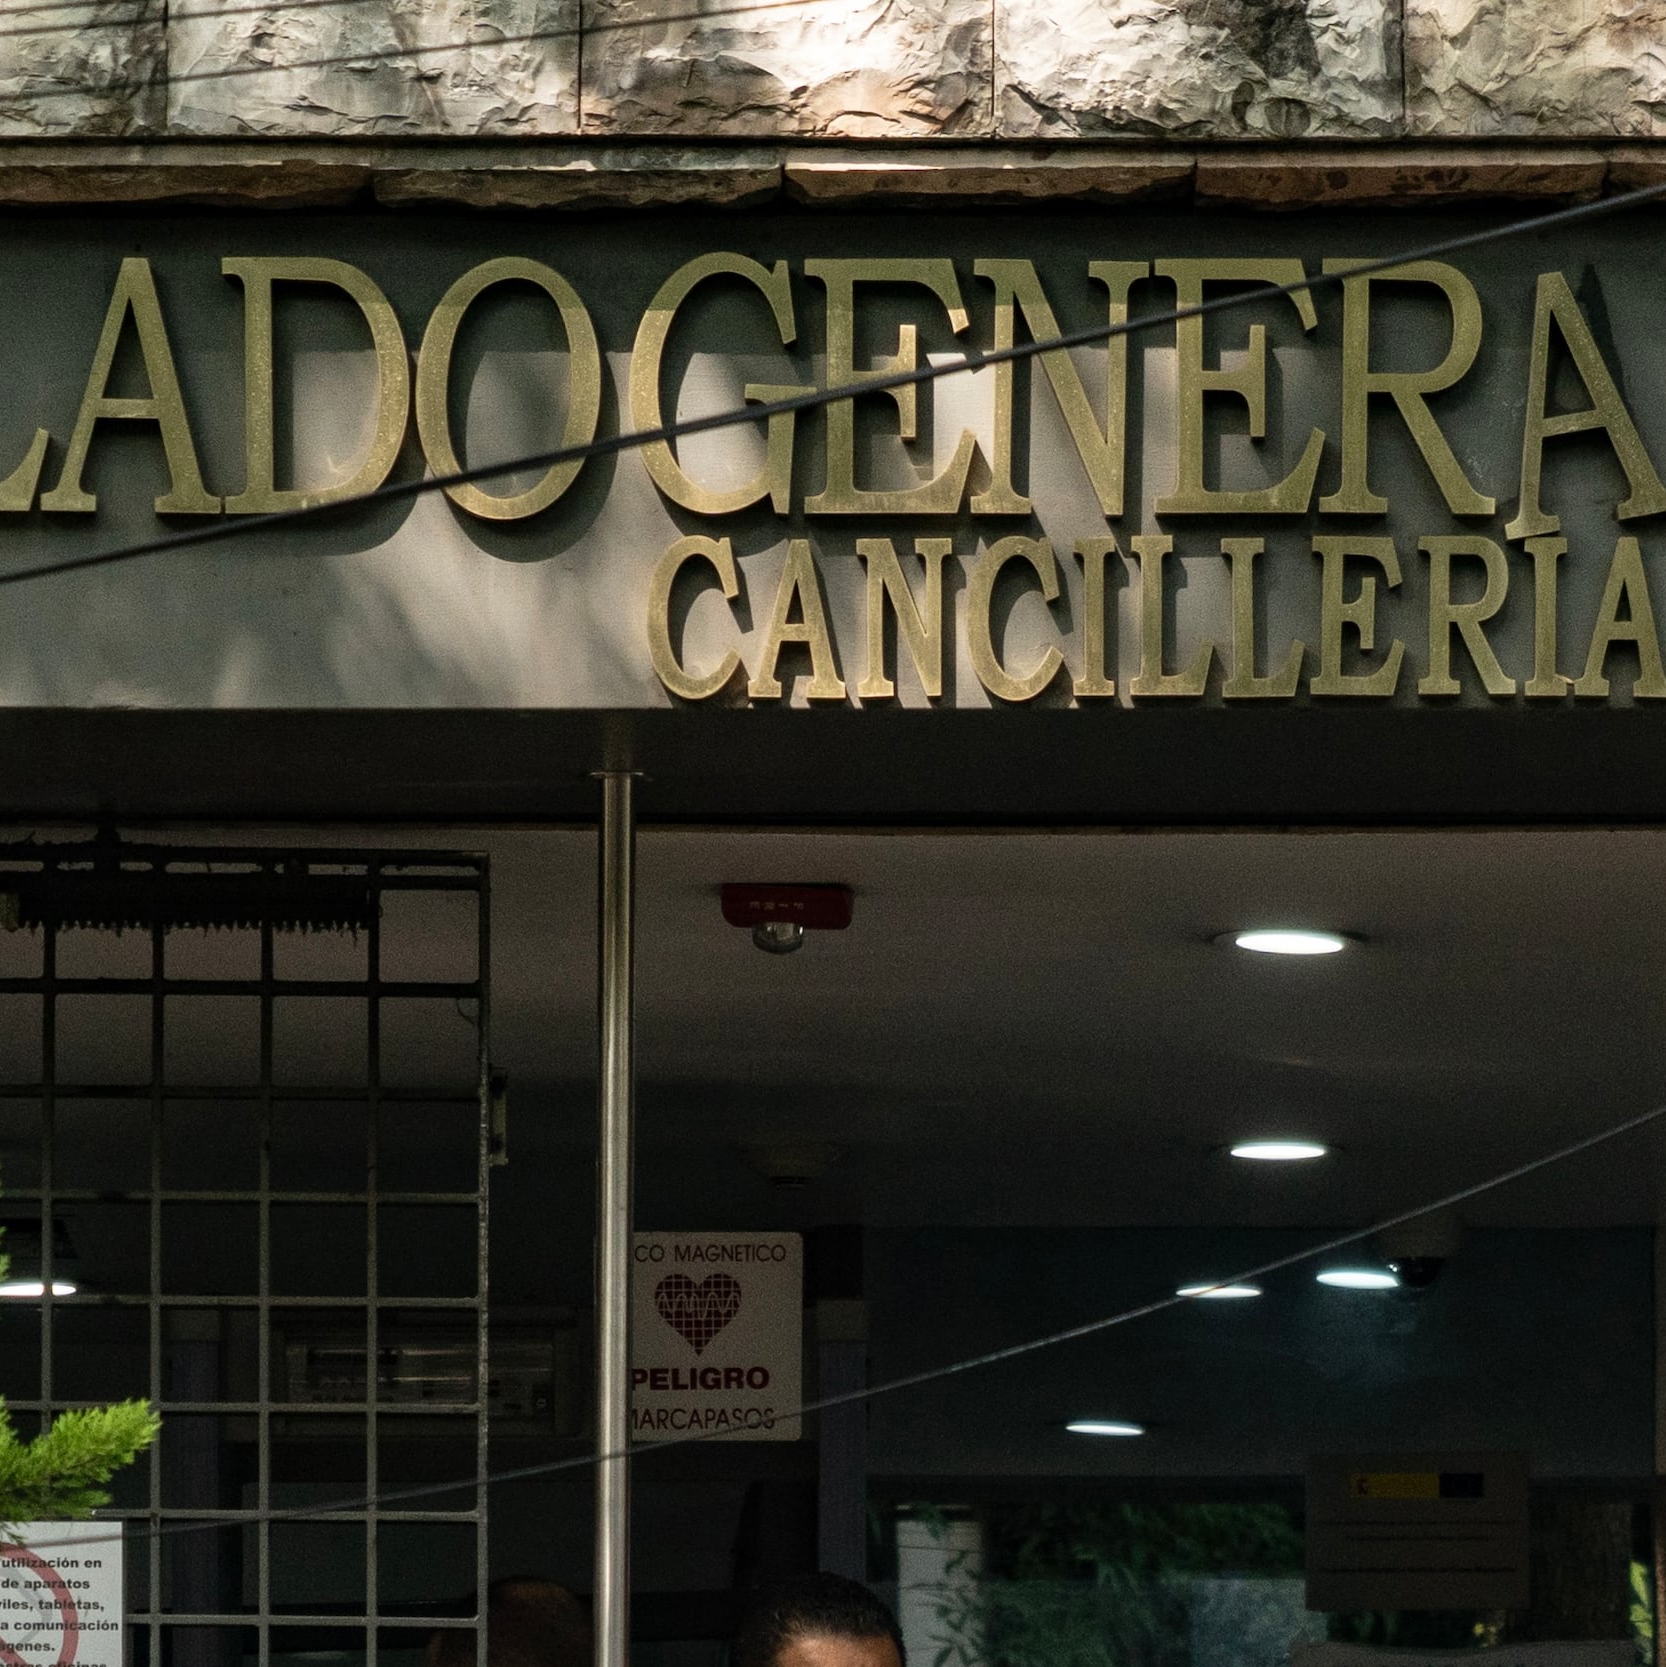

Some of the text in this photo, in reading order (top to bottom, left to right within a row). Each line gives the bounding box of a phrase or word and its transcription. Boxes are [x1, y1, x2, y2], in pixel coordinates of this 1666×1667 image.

[674, 1244, 786, 1263] MAGNETICO
[632, 1366, 770, 1391] PELIGRO
[633, 1408, 775, 1430] ARCAPASOS
[2, 1557, 79, 1568] utilización
[84, 1559, 102, 1568] en
[1, 1578, 19, 1589] de
[24, 1580, 90, 1592] aparatos
[38, 1599, 105, 1612] tabletas,
[13, 1619, 119, 1631] comunicación
